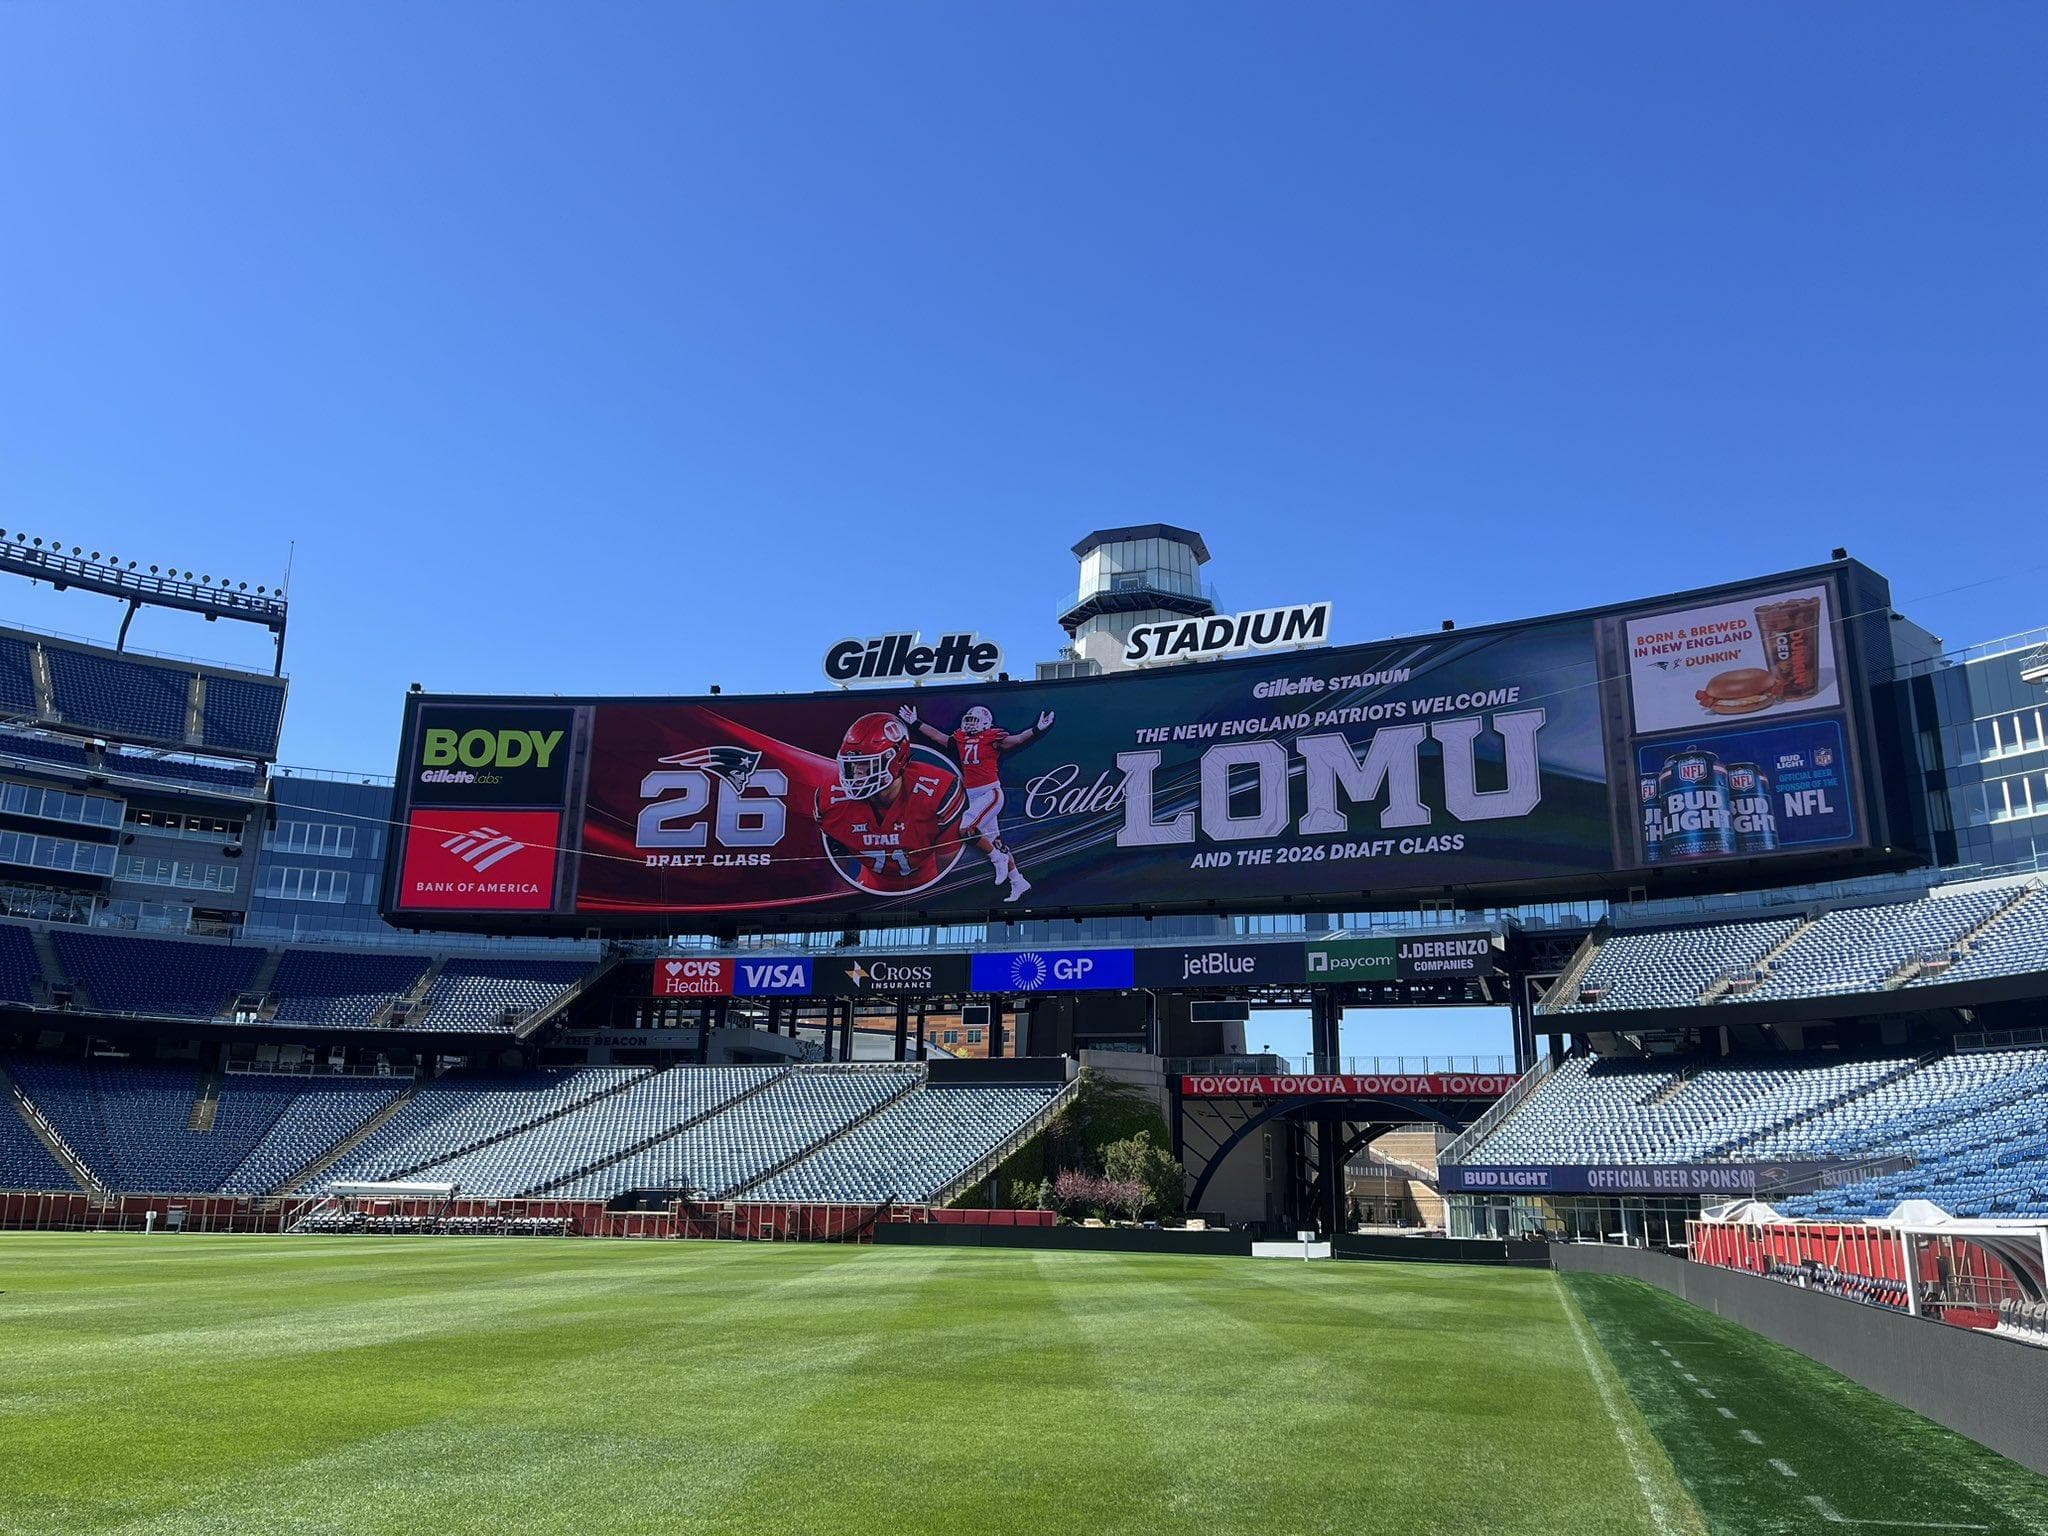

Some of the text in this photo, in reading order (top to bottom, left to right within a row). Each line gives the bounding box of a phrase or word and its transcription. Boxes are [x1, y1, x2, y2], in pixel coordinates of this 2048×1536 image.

[1126, 606, 1326, 660] STADIUM
[1637, 620, 1748, 645] BORN & BREWED
[1634, 630, 1753, 658] IN NEW ENGLAND
[824, 634, 999, 680] Gillette
[1253, 668, 1411, 699] Gillette STADIUM
[1136, 687, 1520, 744] THE NEW ENGLAND PATRIOTS WELCOME
[423, 729, 564, 768] BODY
[963, 744, 981, 765] 71
[1780, 754, 1800, 763] BUD
[1682, 765, 1705, 777] NFL
[1776, 760, 1805, 769] LIGHT
[913, 776, 940, 797] 71
[1025, 708, 1546, 847] Caleb LOMU
[1732, 777, 1752, 787] NFL
[636, 769, 789, 847] 26
[1668, 790, 1723, 814] BUD
[1784, 788, 1834, 817] NFL
[1663, 809, 1731, 835] LIGHT
[1733, 815, 1775, 833] GHT
[863, 834, 900, 846] UTAH
[646, 853, 771, 867] DRAFT CLASS
[1191, 834, 1465, 869] AND THE 2026 DRAFT CLASS
[860, 850, 912, 876] 71
[416, 882, 539, 893] BANK OF AMERICA
[1399, 938, 1489, 960] J.DERENZO
[683, 961, 721, 977] CVS
[1182, 952, 1255, 980] jetBlue
[1330, 955, 1391, 971] paycom
[1414, 958, 1474, 971] COMPANIES
[741, 965, 806, 988] VISA
[871, 981, 932, 989] INSURANCE
[565, 1036, 647, 1046] THE BEACON
[1190, 1076, 1516, 1093] TOYOTA TOYOTA TOYOTA TOYOTA
[1464, 1171, 1548, 1186] BUD LIGHT
[1587, 1168, 1756, 1188] OFFICIAL BEER SPONSOR
